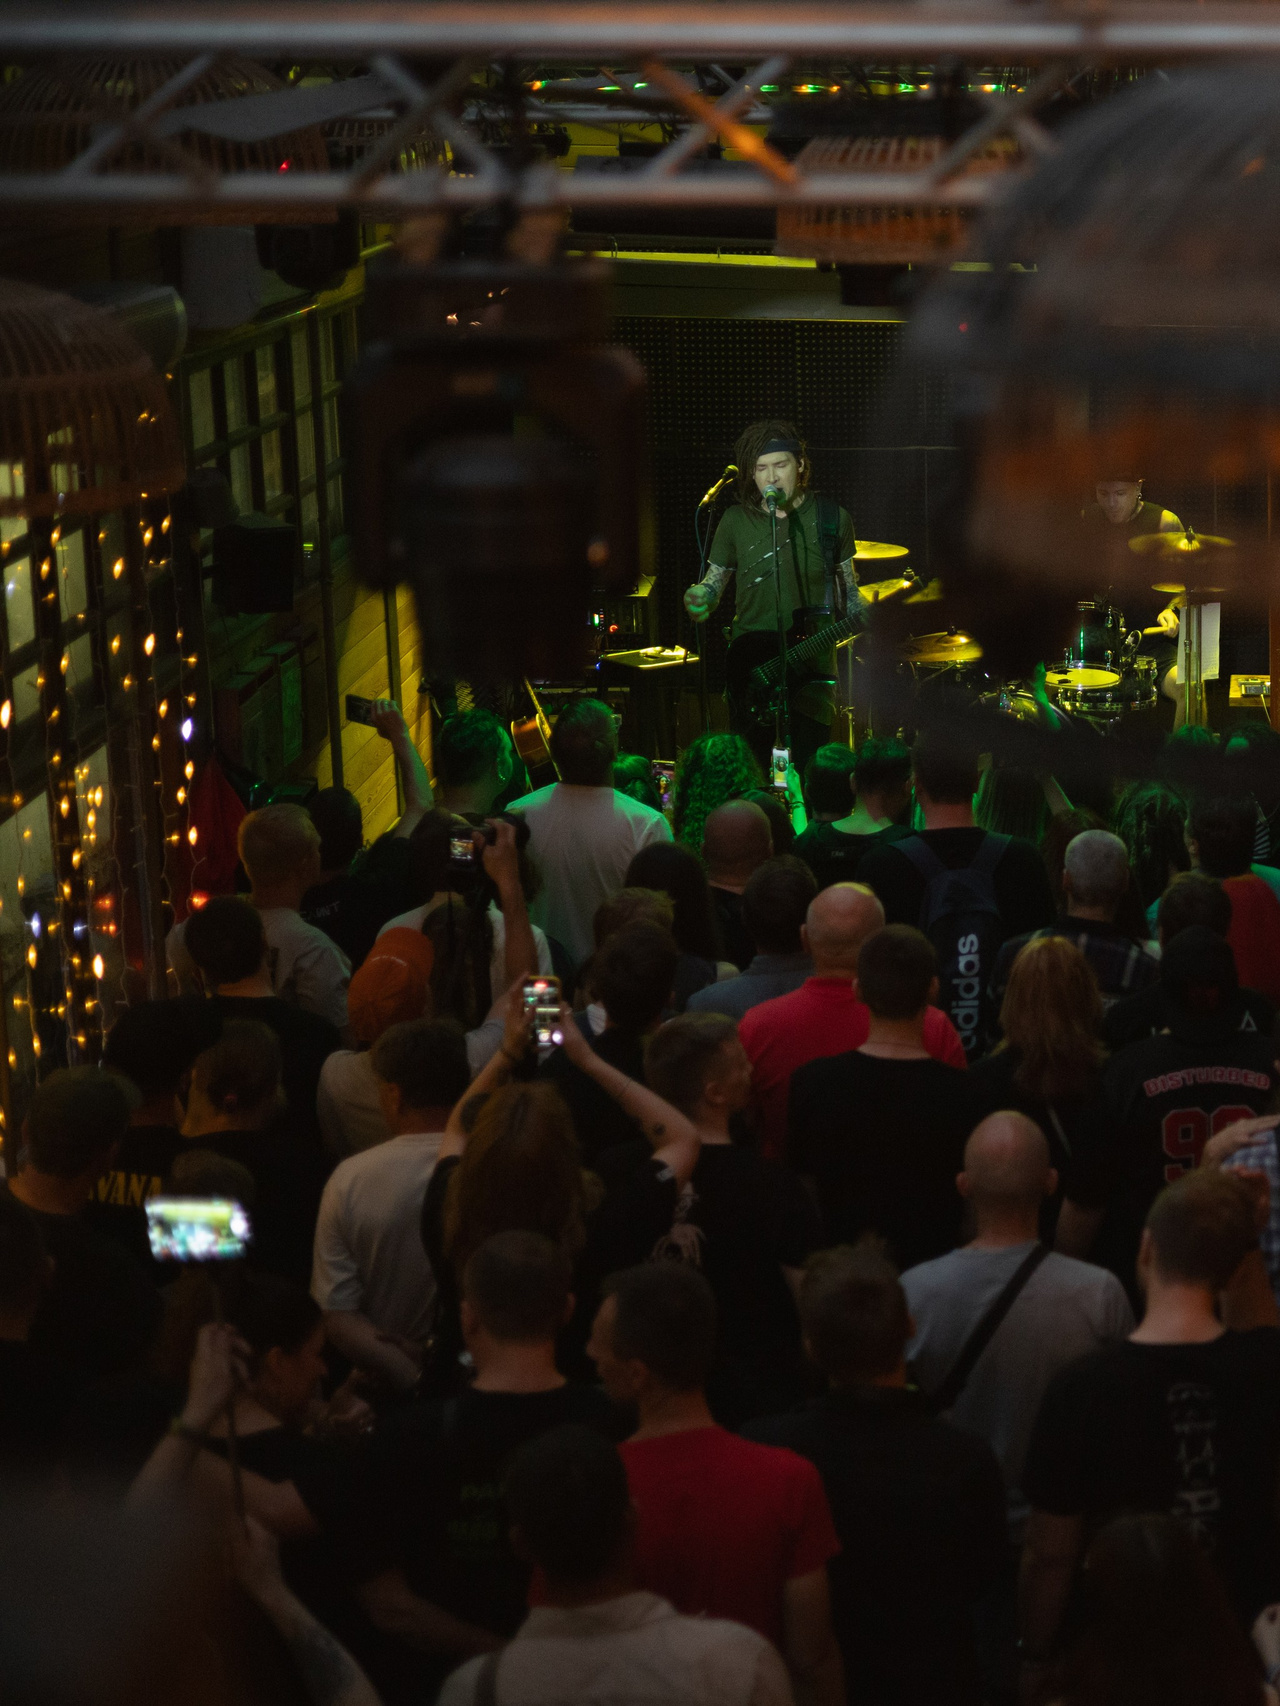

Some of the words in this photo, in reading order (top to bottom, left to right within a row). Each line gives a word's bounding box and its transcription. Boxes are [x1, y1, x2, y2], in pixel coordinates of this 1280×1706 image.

[951, 933, 980, 1052] adidas
[1143, 1066, 1271, 1098] DISTURBED
[87, 1170, 162, 1208] VANA
